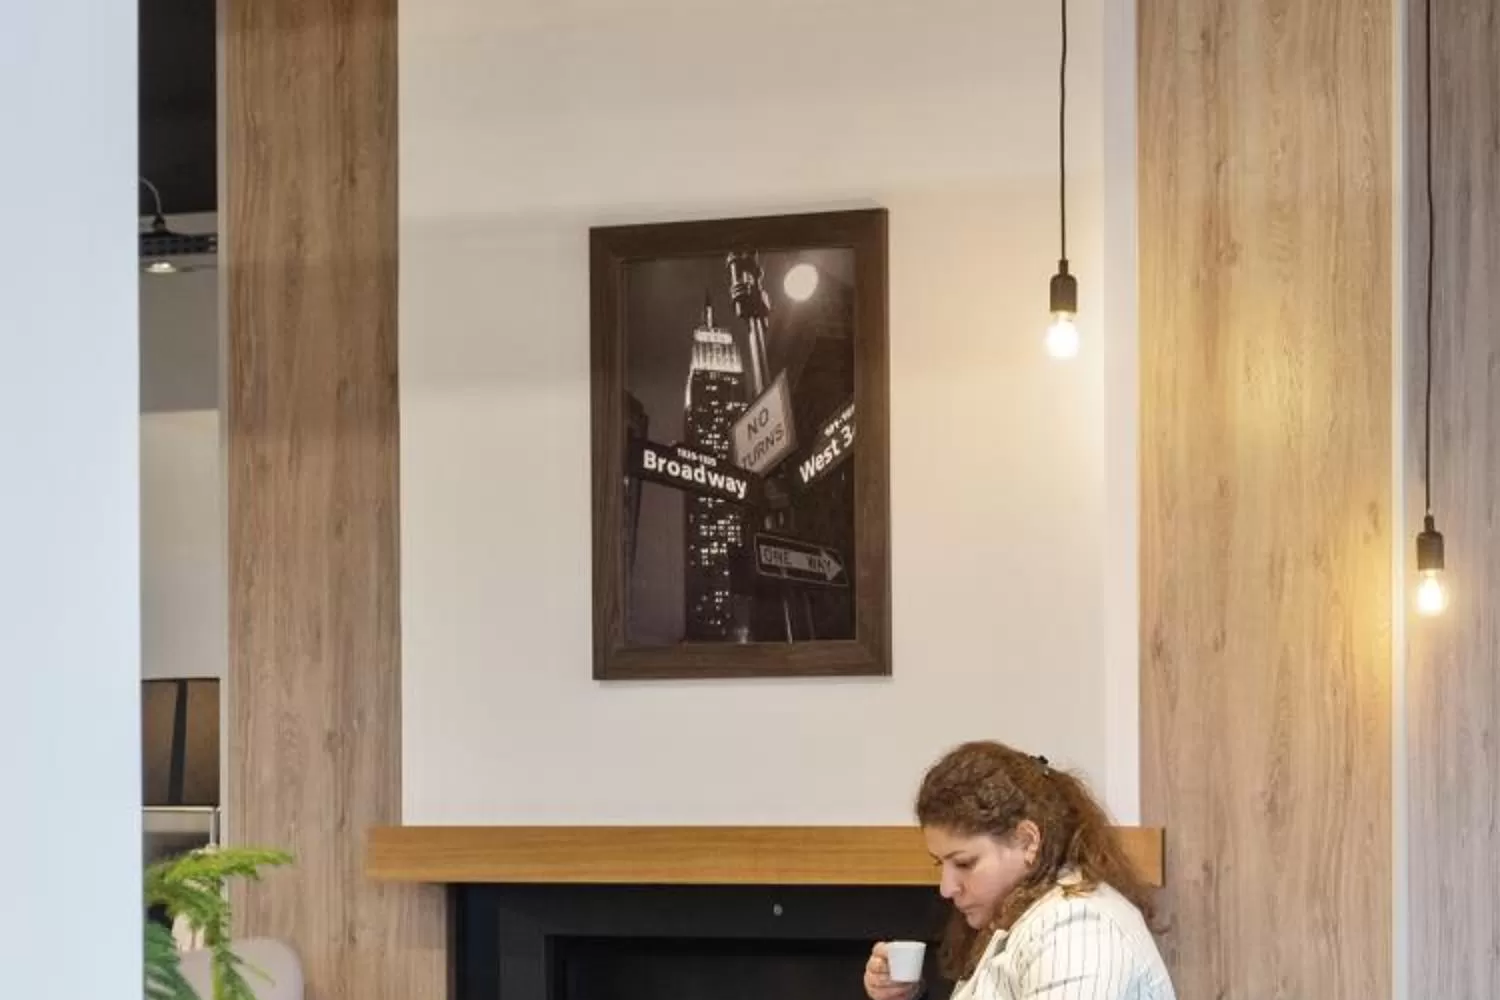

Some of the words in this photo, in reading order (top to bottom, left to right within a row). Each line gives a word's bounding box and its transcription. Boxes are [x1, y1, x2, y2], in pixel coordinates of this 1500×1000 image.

[742, 423, 784, 470] TURNS
[747, 407, 769, 440] NO
[643, 448, 747, 499] Broadway
[799, 438, 841, 483] West
[840, 424, 855, 448] 3
[762, 547, 792, 566] ONE
[807, 556, 832, 573] WAY
